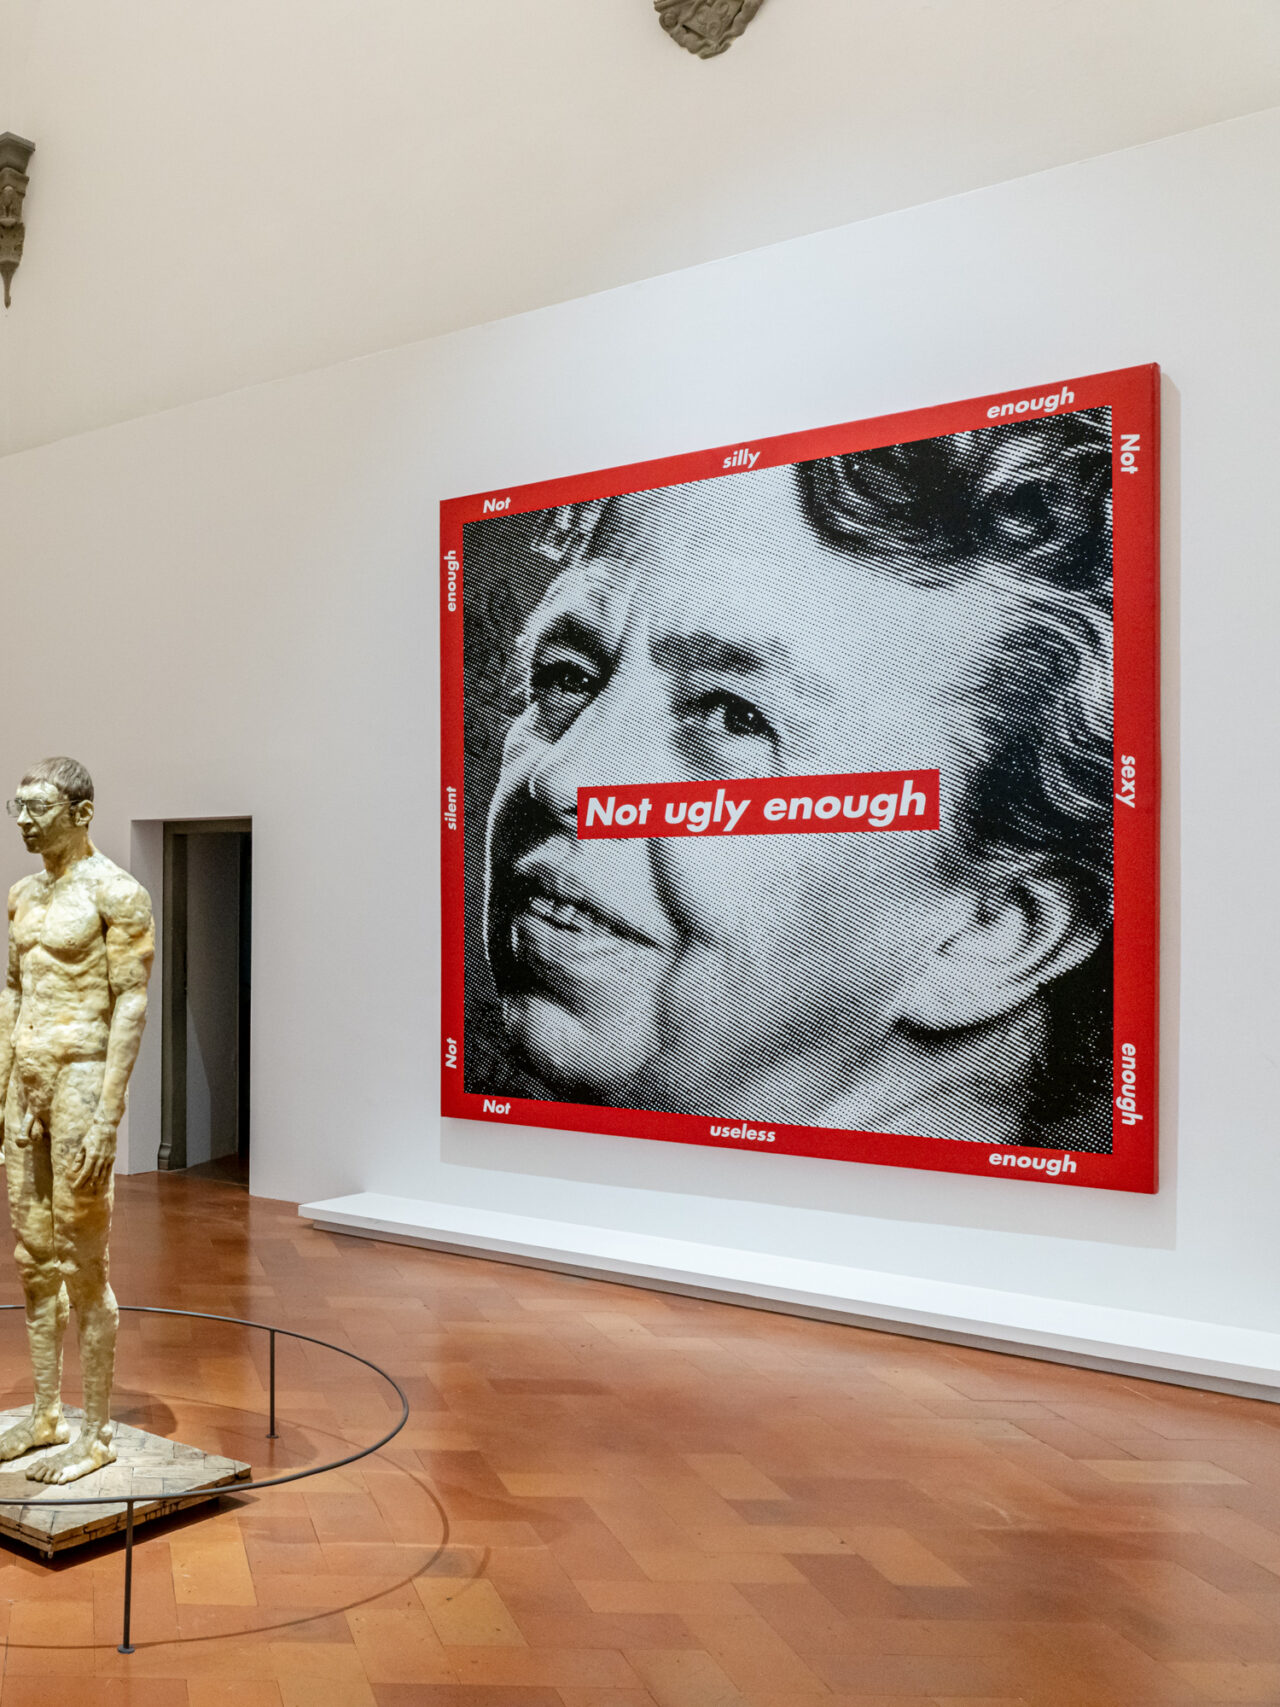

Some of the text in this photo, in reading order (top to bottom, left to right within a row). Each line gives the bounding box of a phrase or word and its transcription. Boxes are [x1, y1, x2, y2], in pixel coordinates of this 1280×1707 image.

[482, 387, 1076, 514] Not silly enough
[443, 549, 460, 1069] Not silent enough
[585, 780, 927, 833] Not ugly enough
[1120, 433, 1144, 1126] Not sexy enough
[482, 1098, 1078, 1177] Not useless enough
